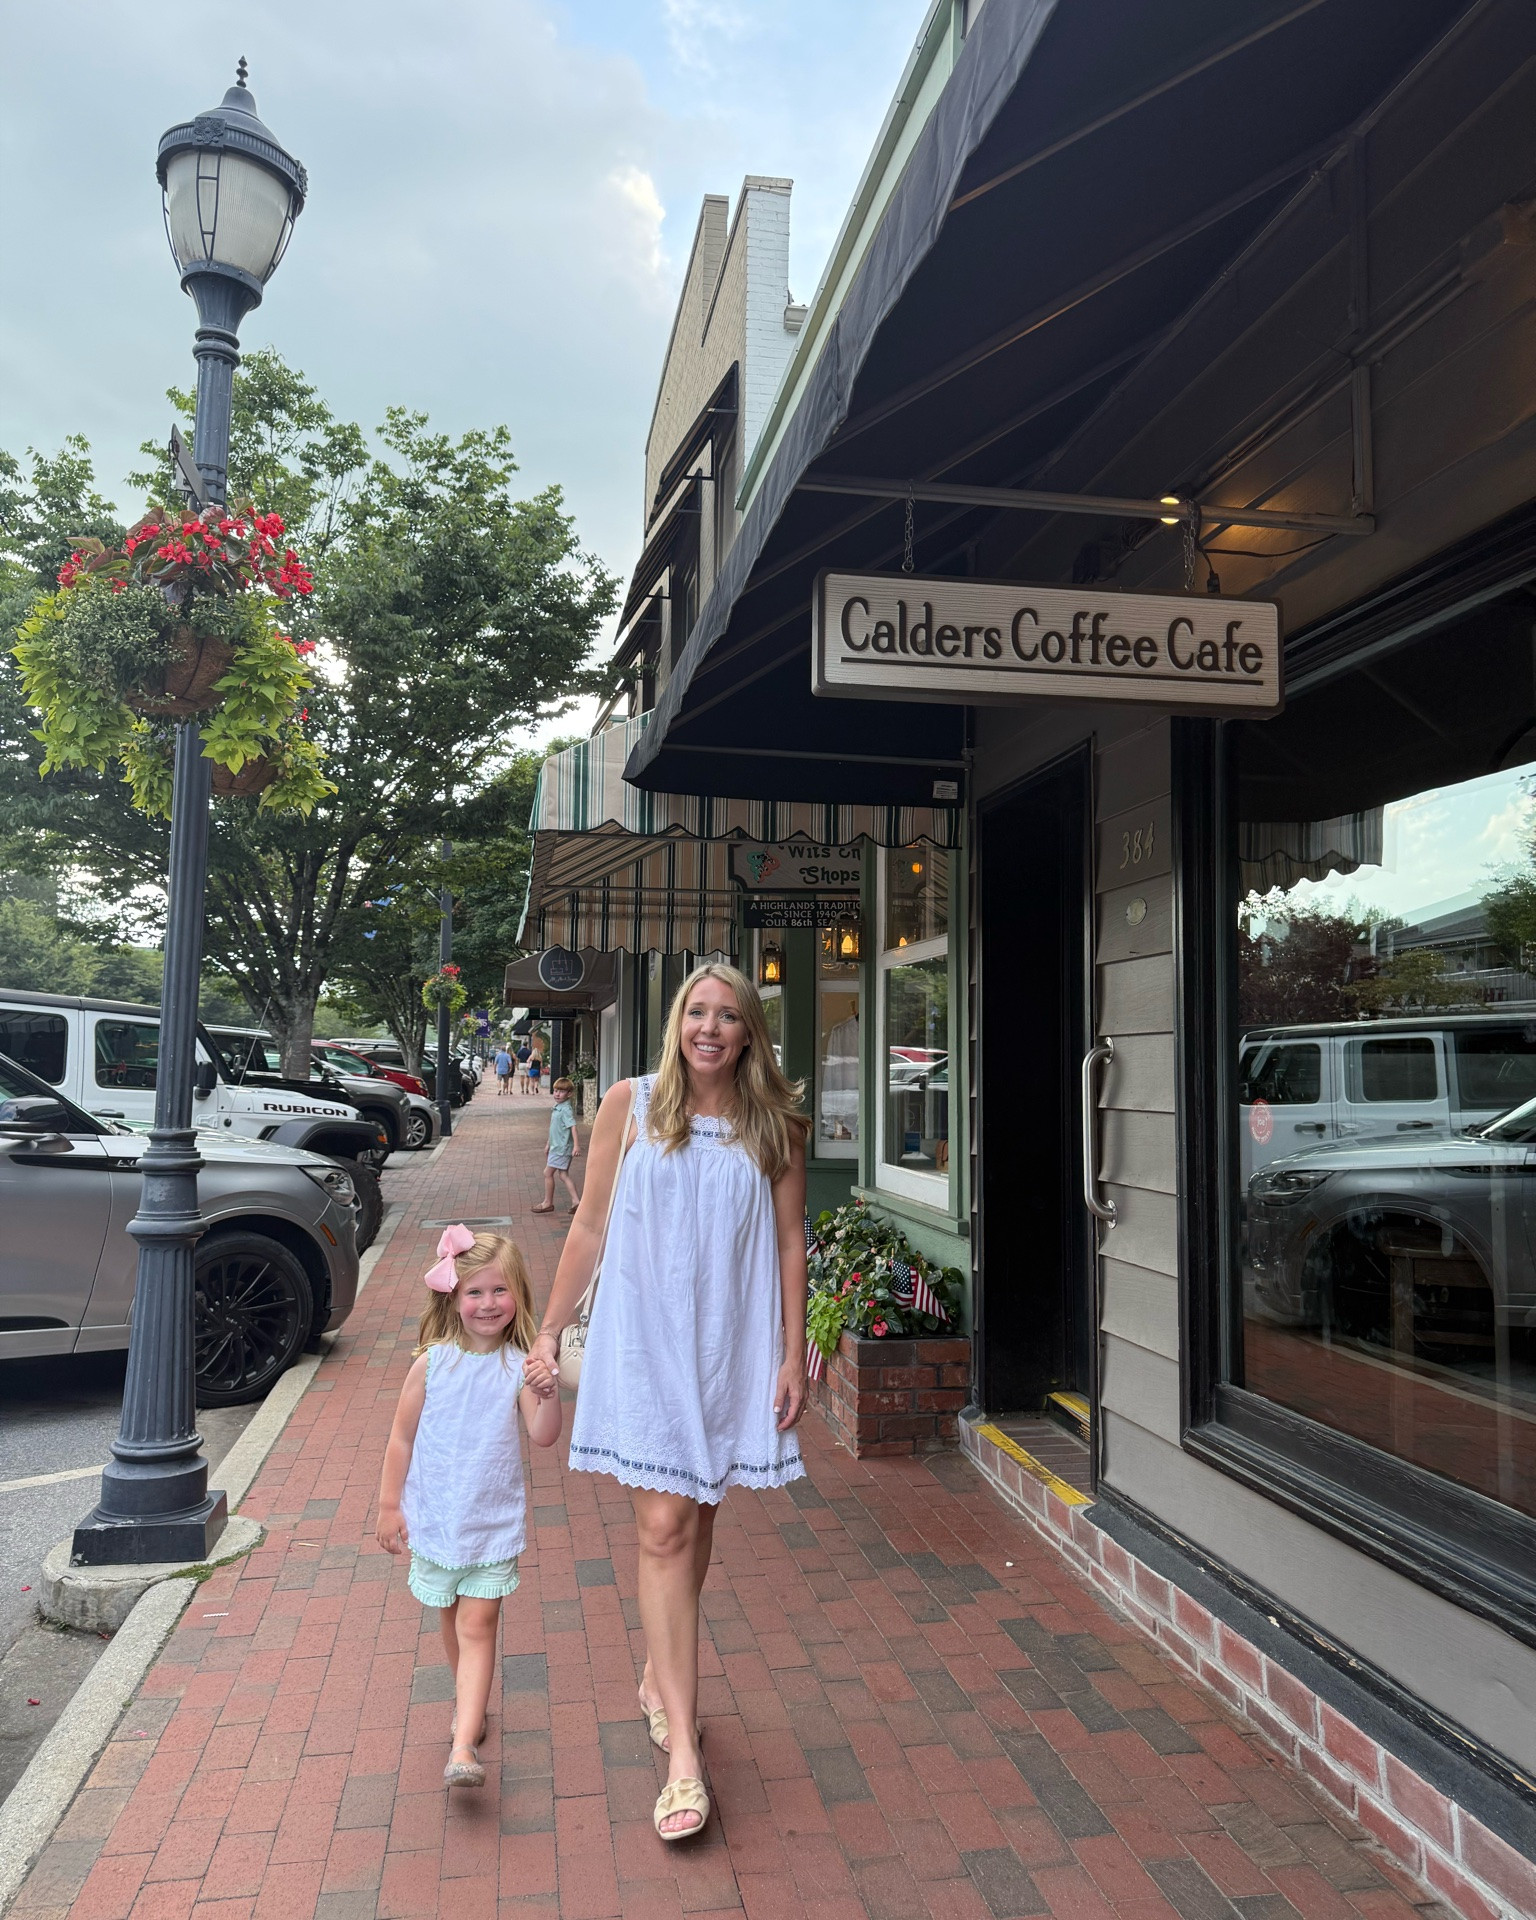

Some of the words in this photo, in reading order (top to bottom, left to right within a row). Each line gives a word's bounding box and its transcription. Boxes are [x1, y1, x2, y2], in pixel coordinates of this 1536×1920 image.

[841, 596, 1002, 659] Calders
[1011, 607, 1158, 668] Coffee
[1167, 617, 1264, 674] Cafe
[1120, 821, 1155, 870] 384
[799, 866, 860, 885] Shops
[750, 902, 757, 910] A
[760, 902, 816, 910] HIGHLANDS
[818, 901, 860, 910] TRADITIO
[784, 910, 812, 918] SINCE
[816, 910, 837, 918] 1940
[791, 919, 813, 927] 86th
[263, 1103, 348, 1117] RUBICON
